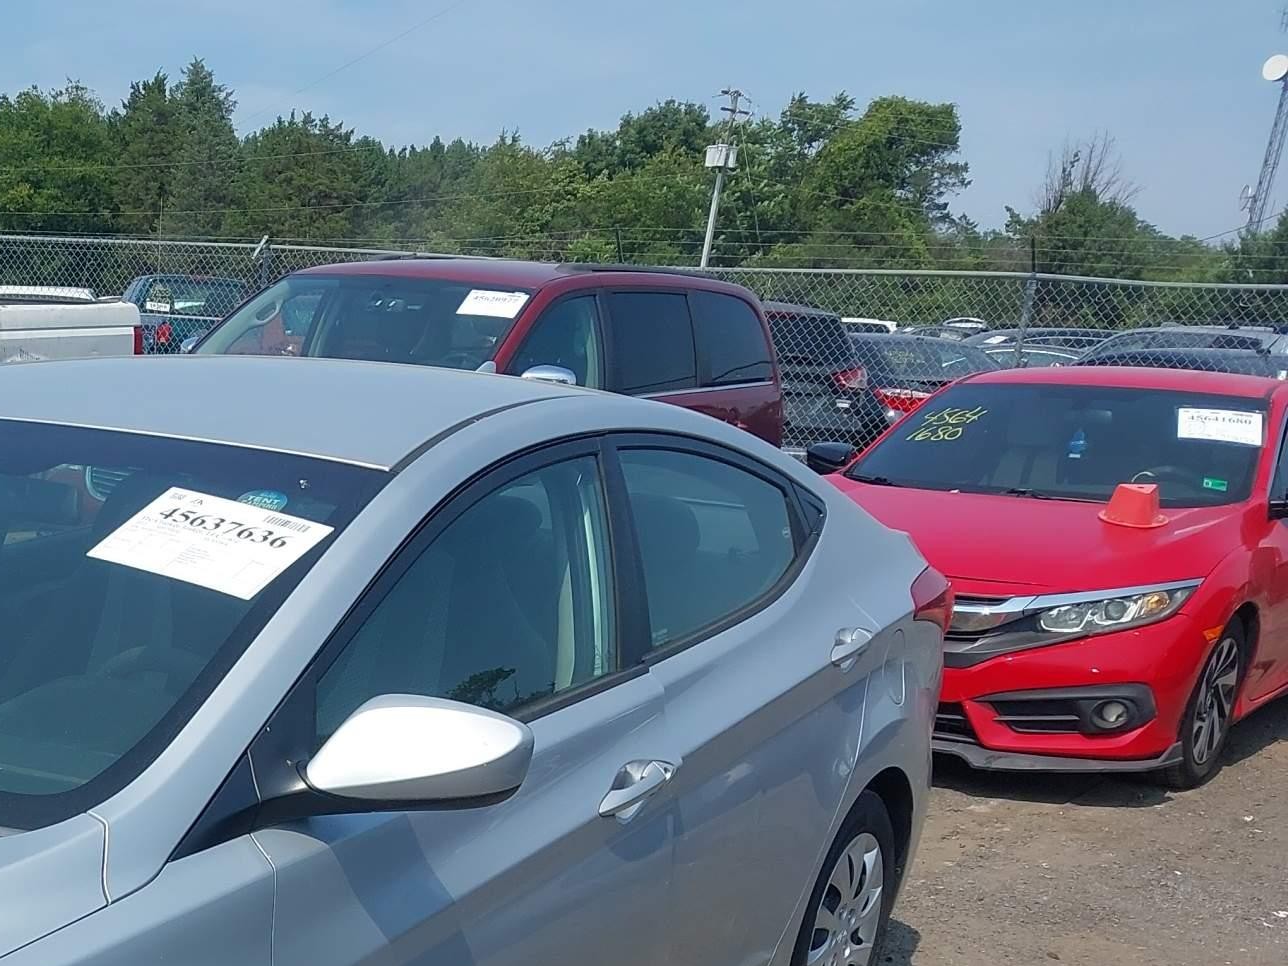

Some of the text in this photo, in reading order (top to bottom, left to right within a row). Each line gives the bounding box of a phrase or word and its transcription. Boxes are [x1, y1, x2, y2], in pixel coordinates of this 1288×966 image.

[921, 406, 988, 427] 4564
[906, 426, 963, 441] 1680
[160, 507, 294, 549] 45637636
